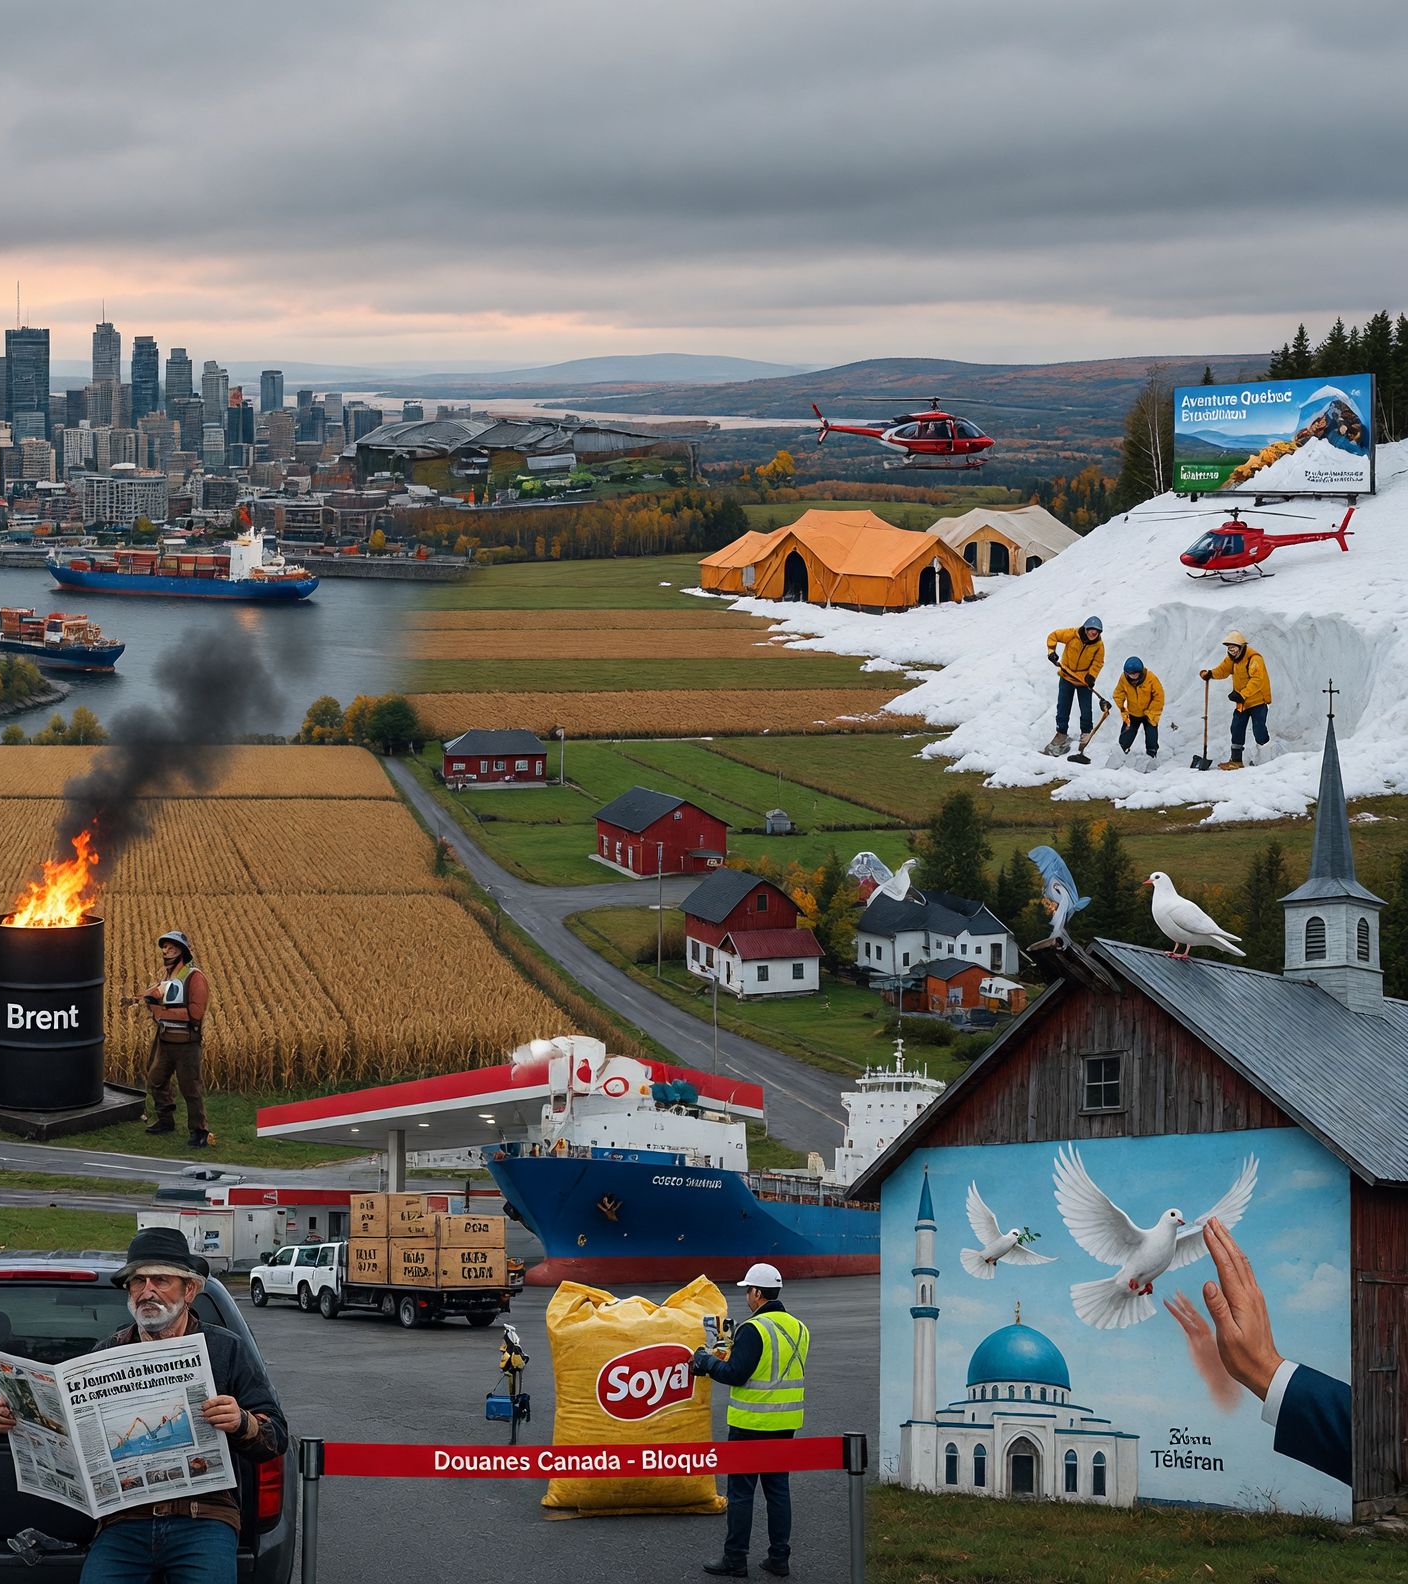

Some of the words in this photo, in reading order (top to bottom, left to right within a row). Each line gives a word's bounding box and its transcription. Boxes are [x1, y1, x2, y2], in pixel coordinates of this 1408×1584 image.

[7, 1003, 79, 1030] Brent
[606, 1362, 689, 1406] Soya
[434, 1450, 530, 1471] Douanes
[537, 1450, 621, 1471] Canada
[642, 1448, 718, 1473] Bloqué
